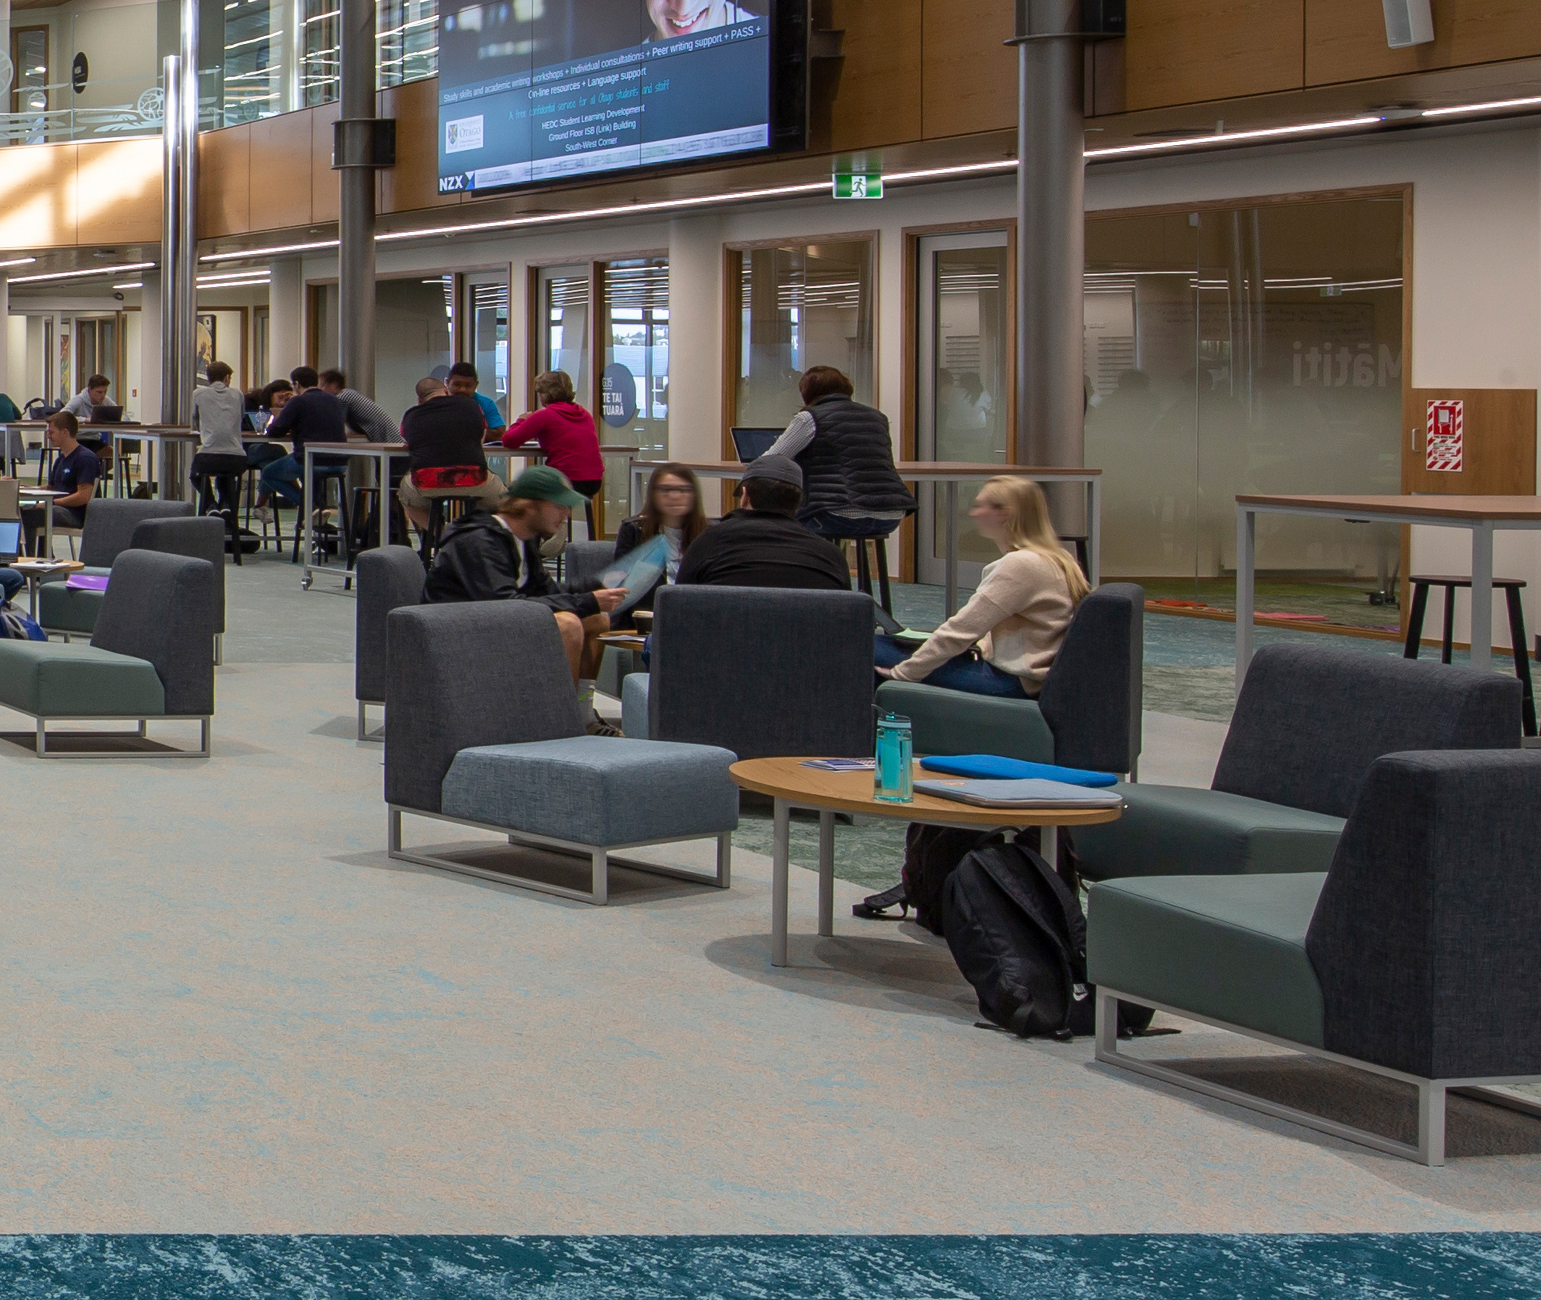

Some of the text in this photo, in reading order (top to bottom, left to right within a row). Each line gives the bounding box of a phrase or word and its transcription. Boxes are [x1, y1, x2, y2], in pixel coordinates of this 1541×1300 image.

[444, 93, 458, 102] Study
[474, 87, 483, 95] and
[485, 81, 511, 93] academic
[532, 70, 564, 82] workshops
[570, 61, 600, 74] Individual
[601, 51, 644, 68] consultations
[652, 46, 668, 56] Peer
[670, 41, 693, 52] writing
[695, 34, 722, 47] support
[730, 26, 753, 39] PASS
[528, 88, 549, 99] On-line
[550, 82, 580, 94] resources
[588, 74, 619, 87] Language
[620, 68, 646, 80] support
[559, 116, 580, 126] Student
[581, 112, 605, 123] Learning
[606, 104, 645, 119] Development
[548, 131, 568, 141] Ground
[569, 129, 583, 138] Floor
[596, 124, 612, 135] (Link)
[613, 120, 636, 131] Building
[565, 137, 617, 152] South-West Corner
[439, 175, 463, 191] NZX
[602, 393, 622, 402] TE TAI
